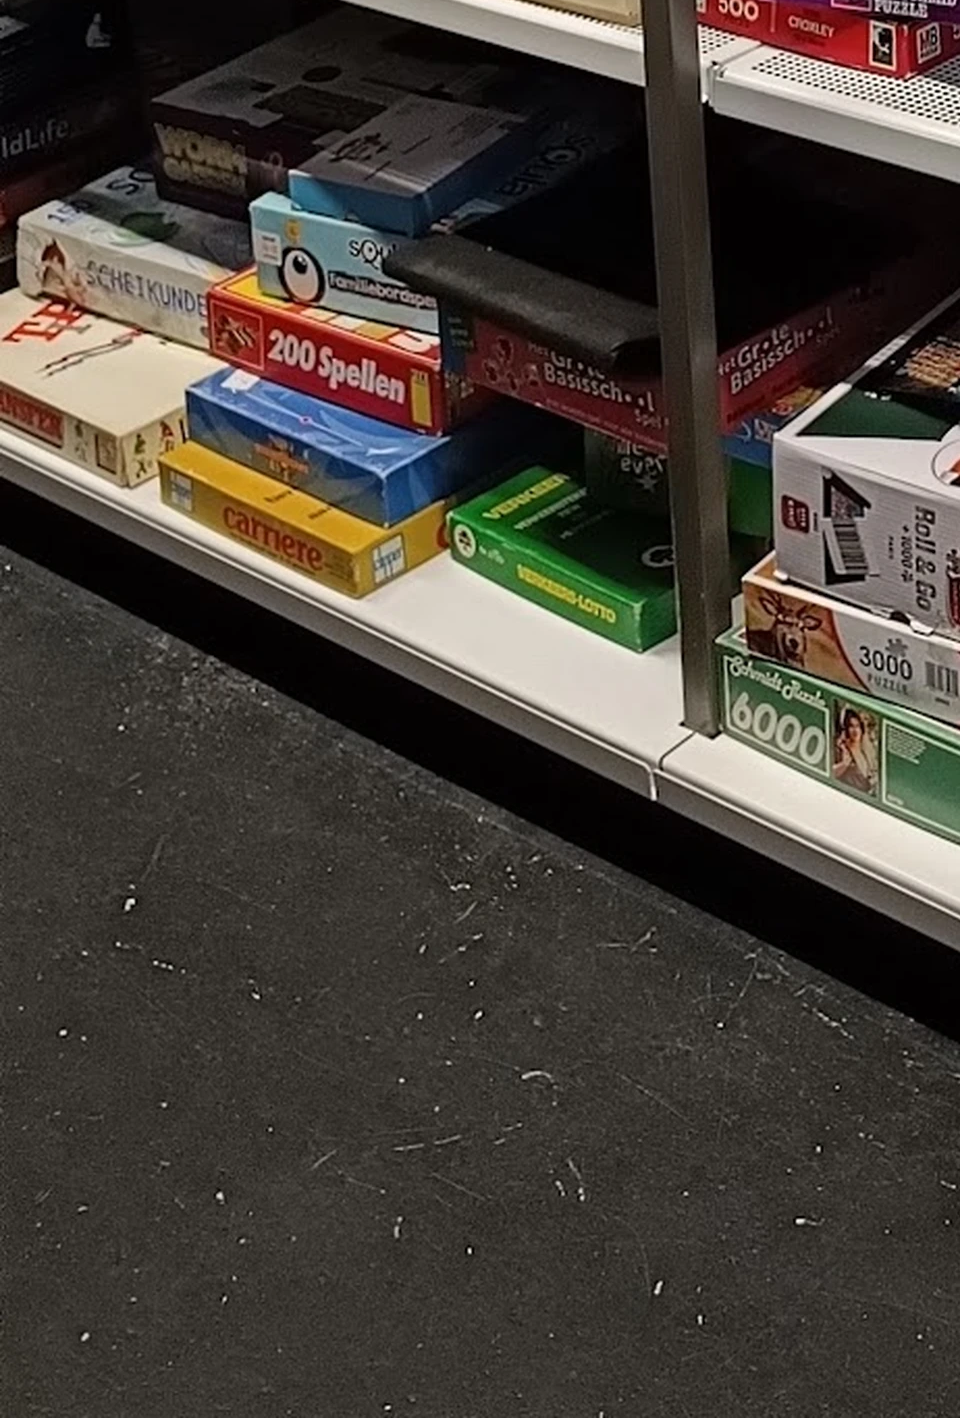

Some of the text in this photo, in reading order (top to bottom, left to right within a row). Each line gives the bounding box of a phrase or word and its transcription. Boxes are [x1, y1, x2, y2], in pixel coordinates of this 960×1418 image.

[86, 259, 207, 319] SCHEIKUNDE
[267, 329, 406, 405] 200 Spellen
[222, 501, 325, 571] carriere
[859, 645, 914, 681] 3000
[730, 691, 827, 765] 6000
